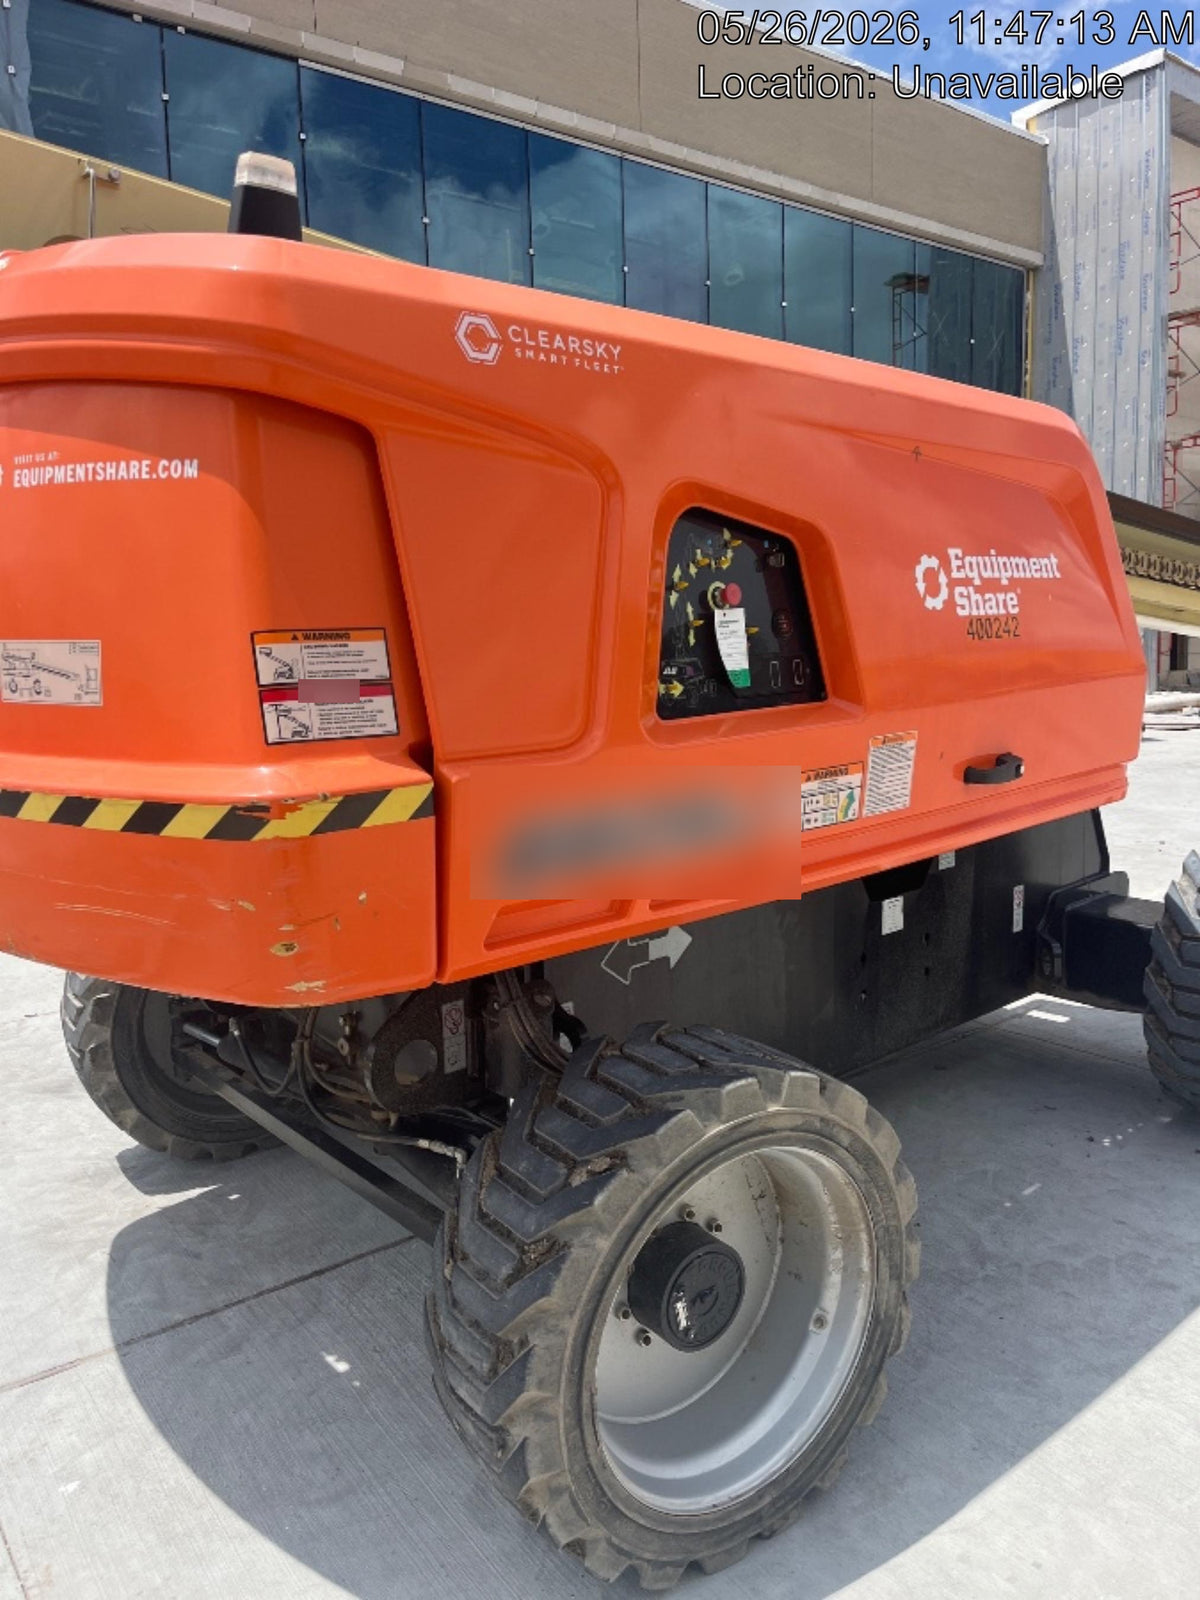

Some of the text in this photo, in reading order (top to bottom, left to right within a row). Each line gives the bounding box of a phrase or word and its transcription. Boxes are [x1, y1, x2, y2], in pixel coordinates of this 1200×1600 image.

[507, 325, 622, 361] CLEARSKY
[515, 347, 621, 375] SMART FLEET
[13, 458, 199, 488] EQUIPMENTSHARE.COM
[947, 547, 1061, 585] Equipment
[954, 585, 1020, 616] Share
[302, 632, 351, 641] WARNING
[966, 616, 1021, 640] 400242
